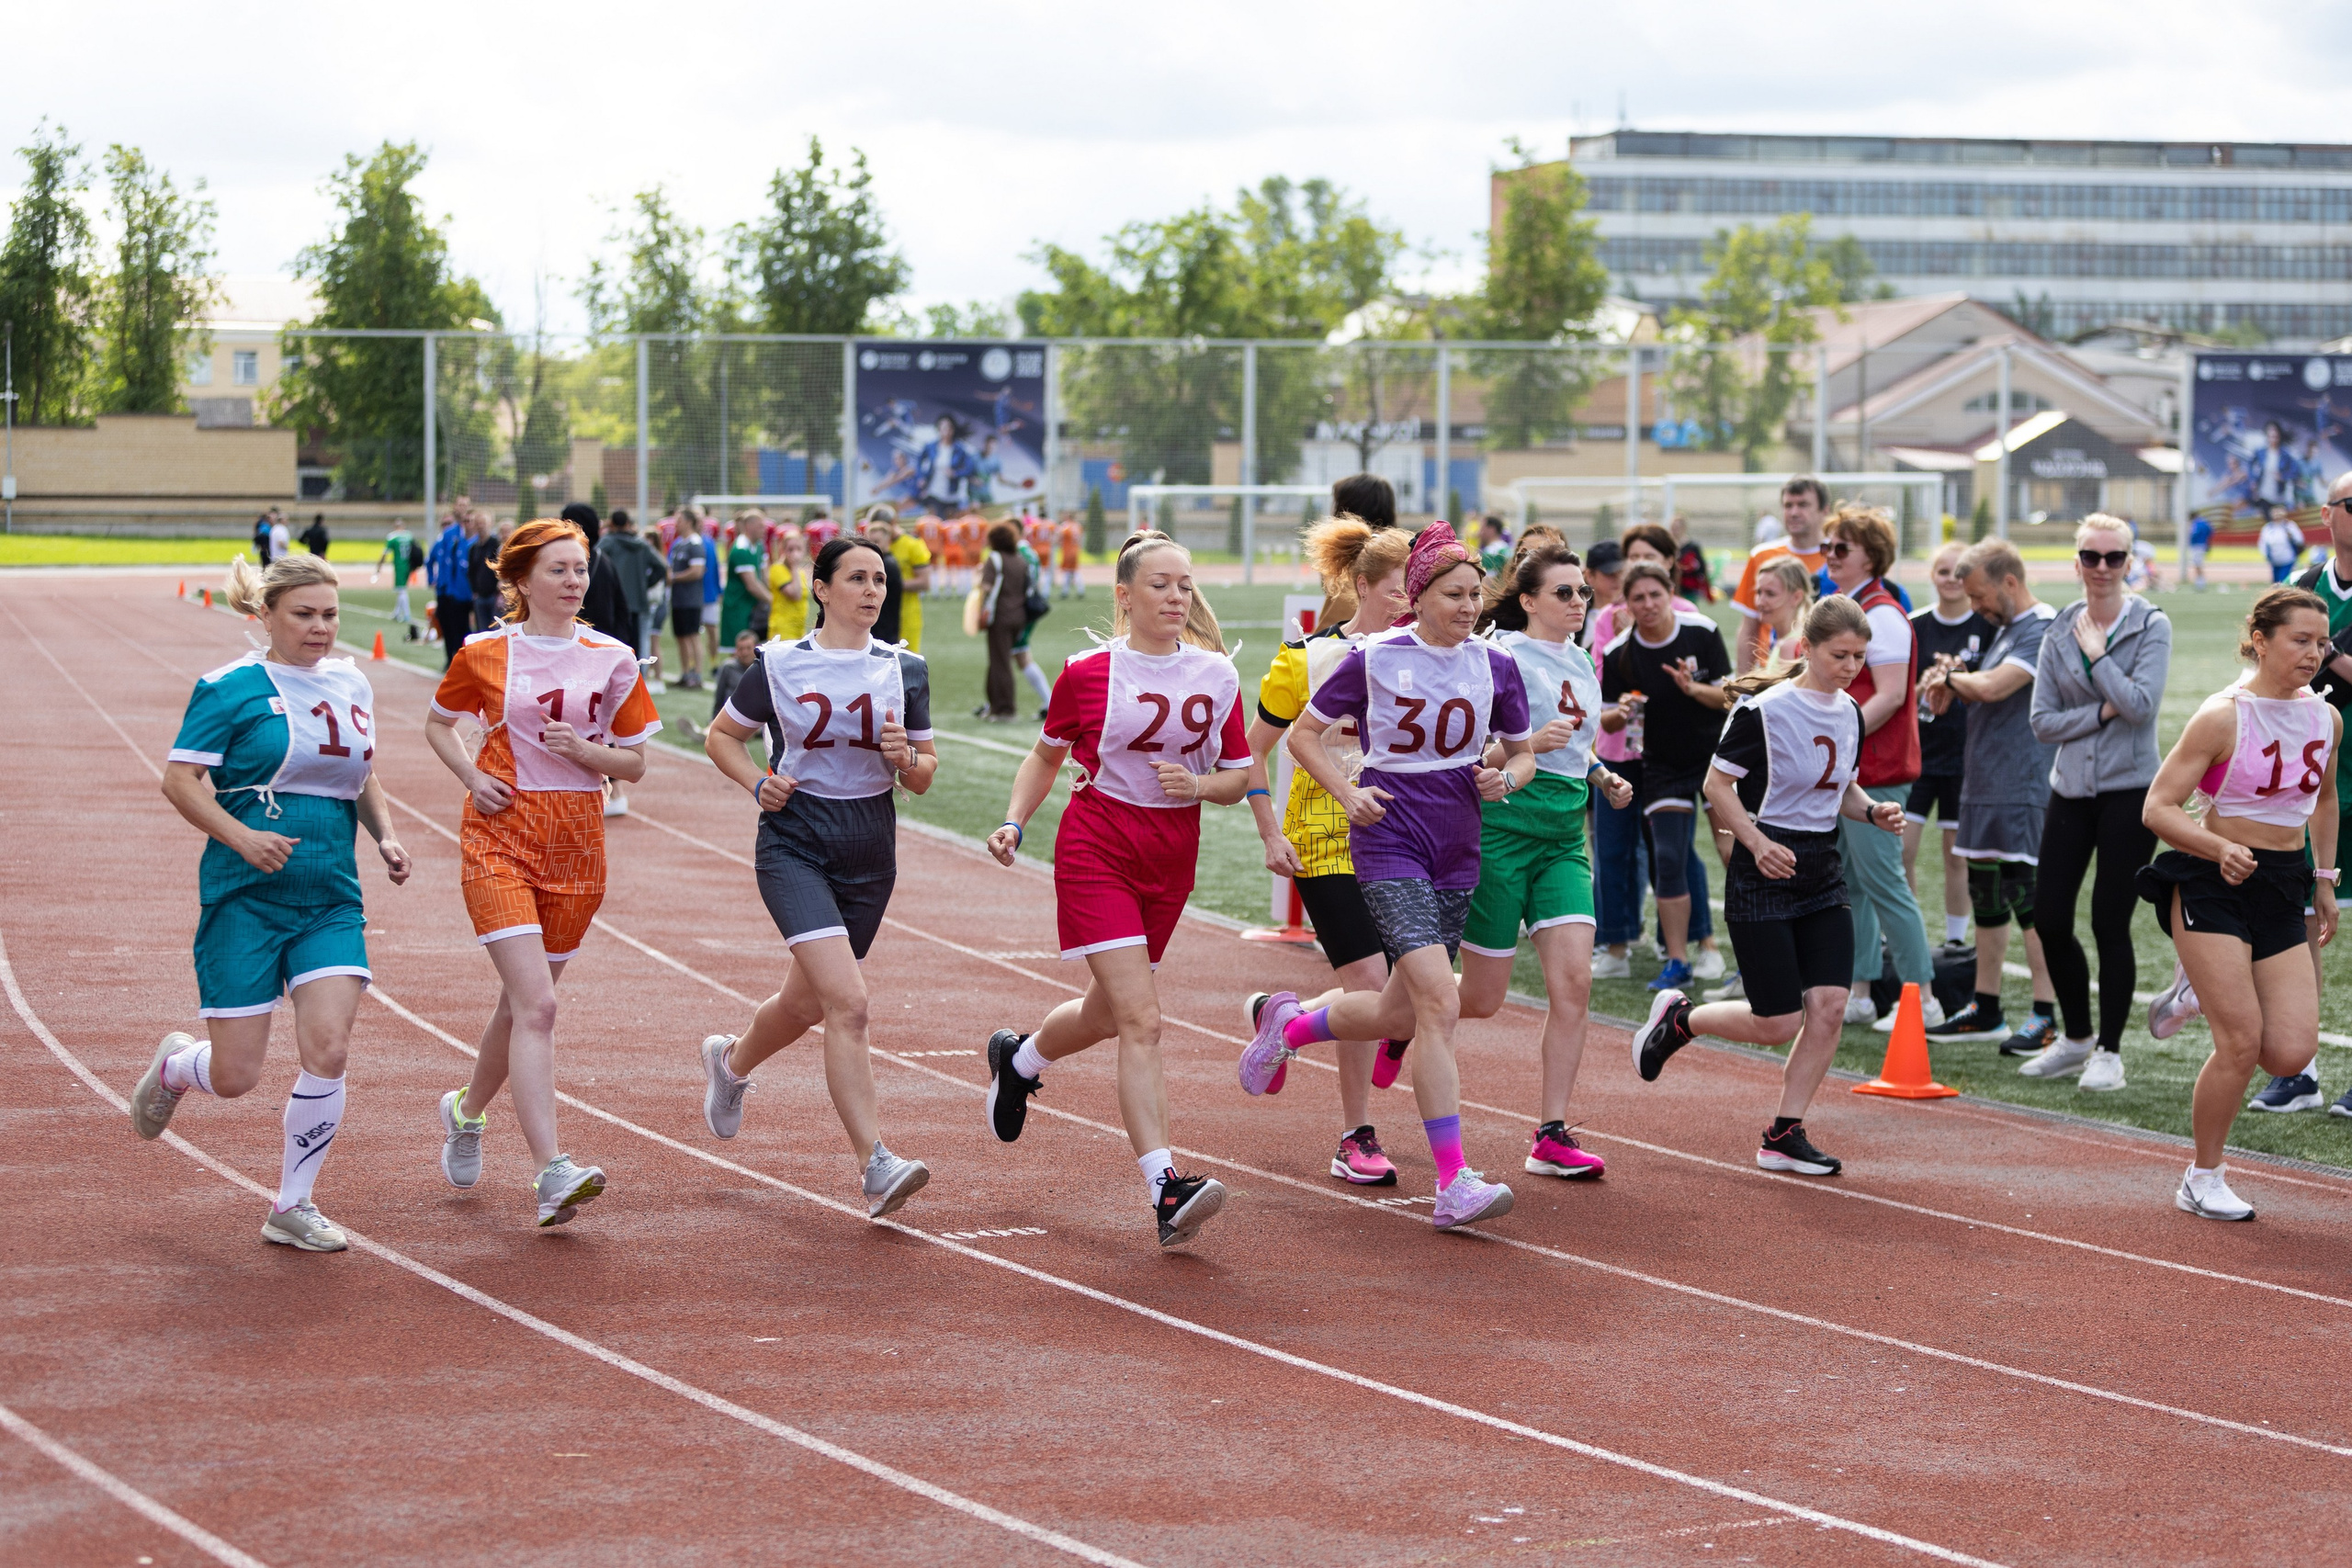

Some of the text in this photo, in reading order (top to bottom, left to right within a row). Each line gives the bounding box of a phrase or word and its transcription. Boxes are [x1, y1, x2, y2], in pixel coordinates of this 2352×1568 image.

[311, 700, 374, 761] 19
[796, 692, 882, 751] 21
[1126, 692, 1215, 754] 29
[1387, 696, 1476, 758] 30
[1557, 680, 1588, 731] 4
[1813, 735, 1839, 791] 2
[2255, 739, 2326, 795] 18
